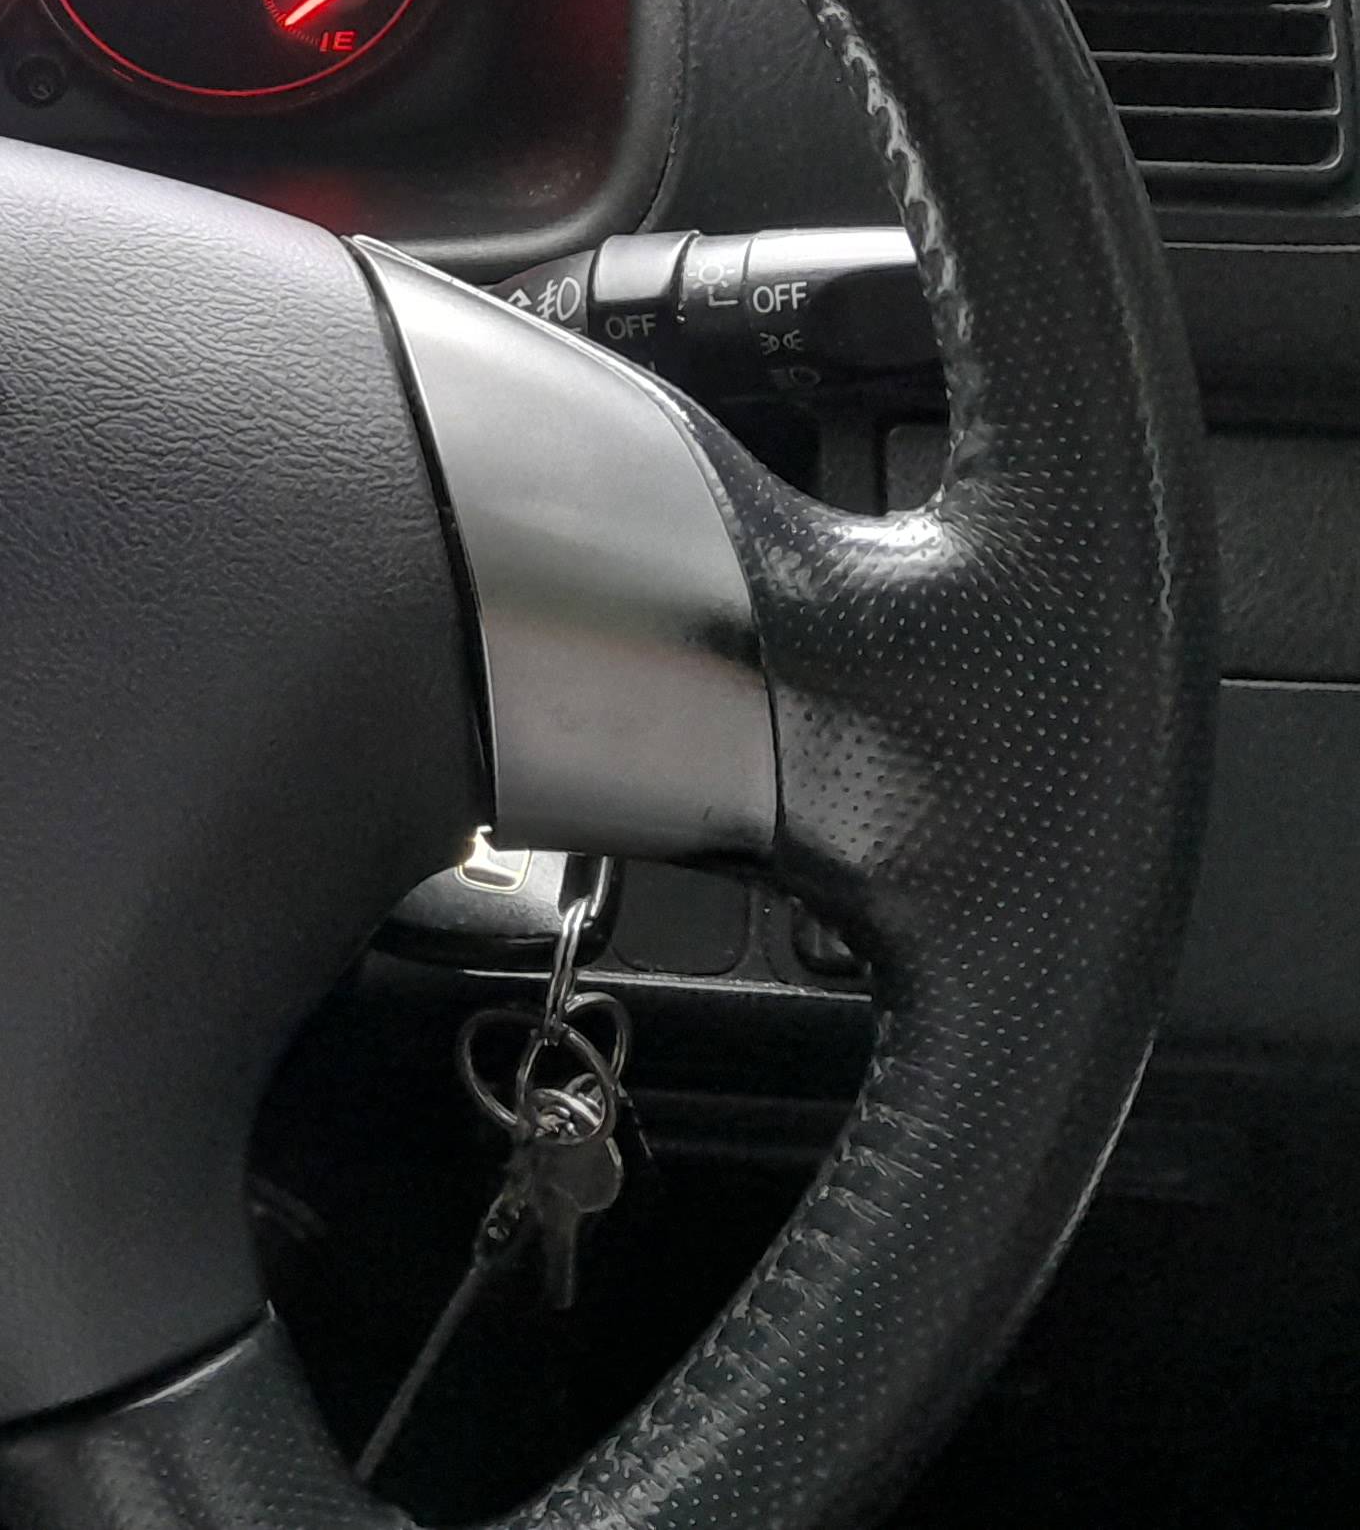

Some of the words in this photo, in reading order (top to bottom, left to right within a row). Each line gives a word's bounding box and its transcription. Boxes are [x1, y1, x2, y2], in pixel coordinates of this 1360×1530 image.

[331, 31, 356, 51] E
[752, 280, 809, 315] OFF
[605, 314, 658, 341] OFF
